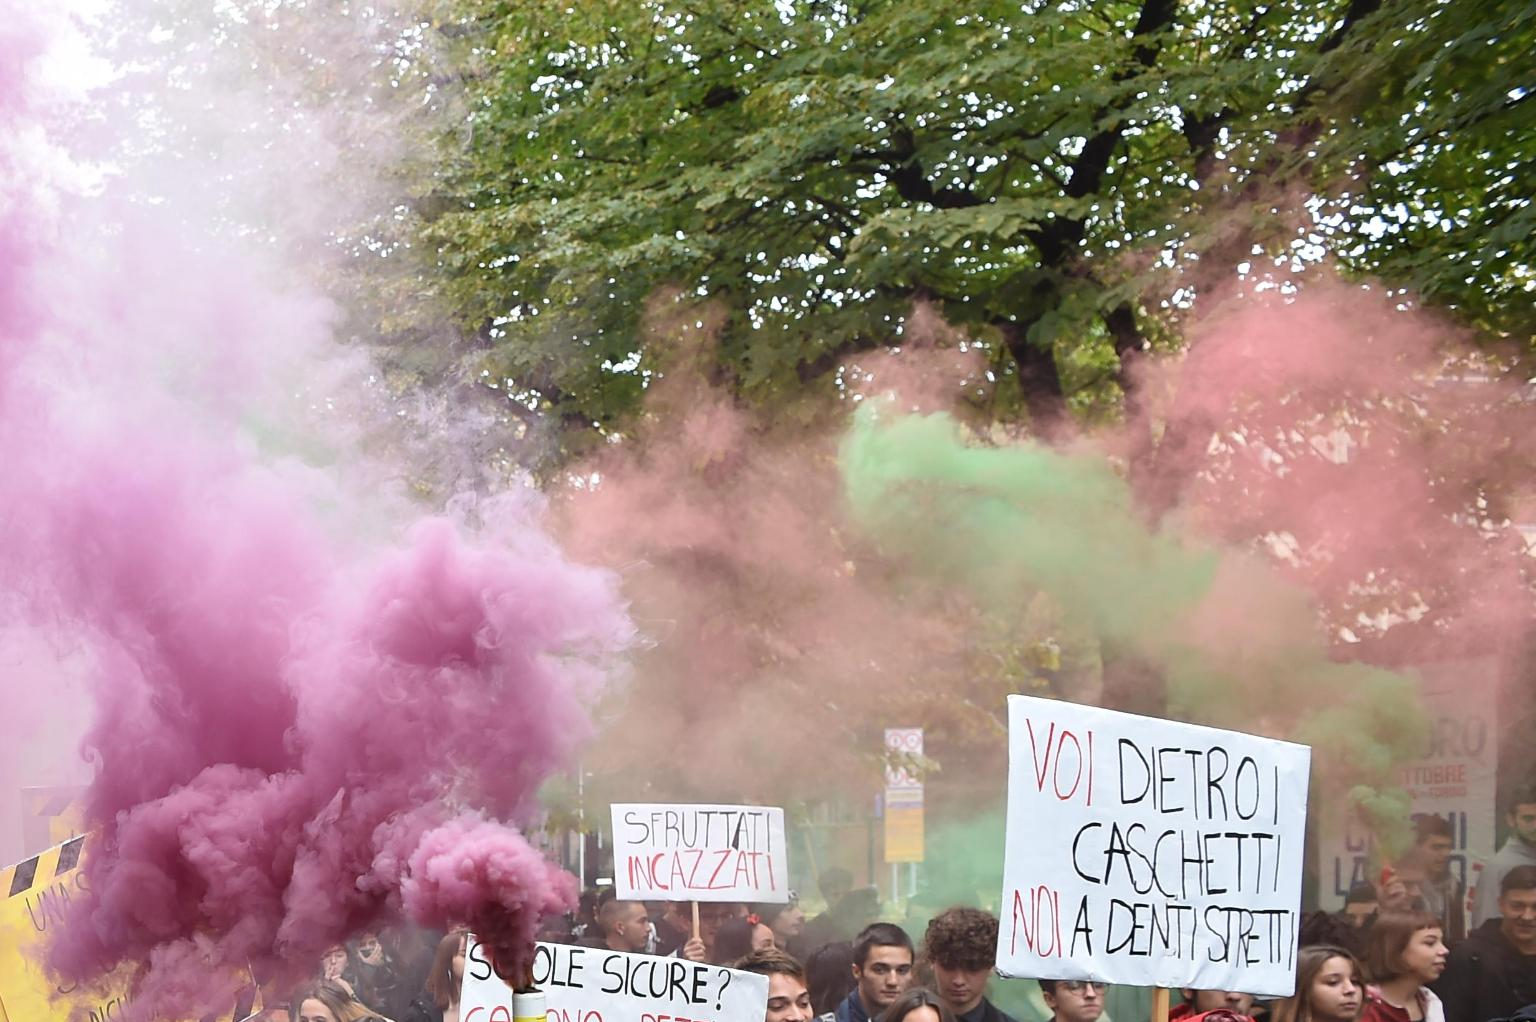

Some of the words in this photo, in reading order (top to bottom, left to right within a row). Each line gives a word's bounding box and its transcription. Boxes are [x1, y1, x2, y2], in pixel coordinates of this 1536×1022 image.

[1025, 717, 1093, 807] VOI
[1117, 737, 1261, 822] DIETRO
[624, 809, 772, 851] SFRUTTATI
[1071, 821, 1283, 901] CASCHETTI
[627, 849, 776, 892] INCAZZATI
[1011, 885, 1062, 959] NOI
[1070, 894, 1093, 957] A
[1105, 897, 1198, 962] DENTI
[1205, 904, 1296, 972] STRETTI
